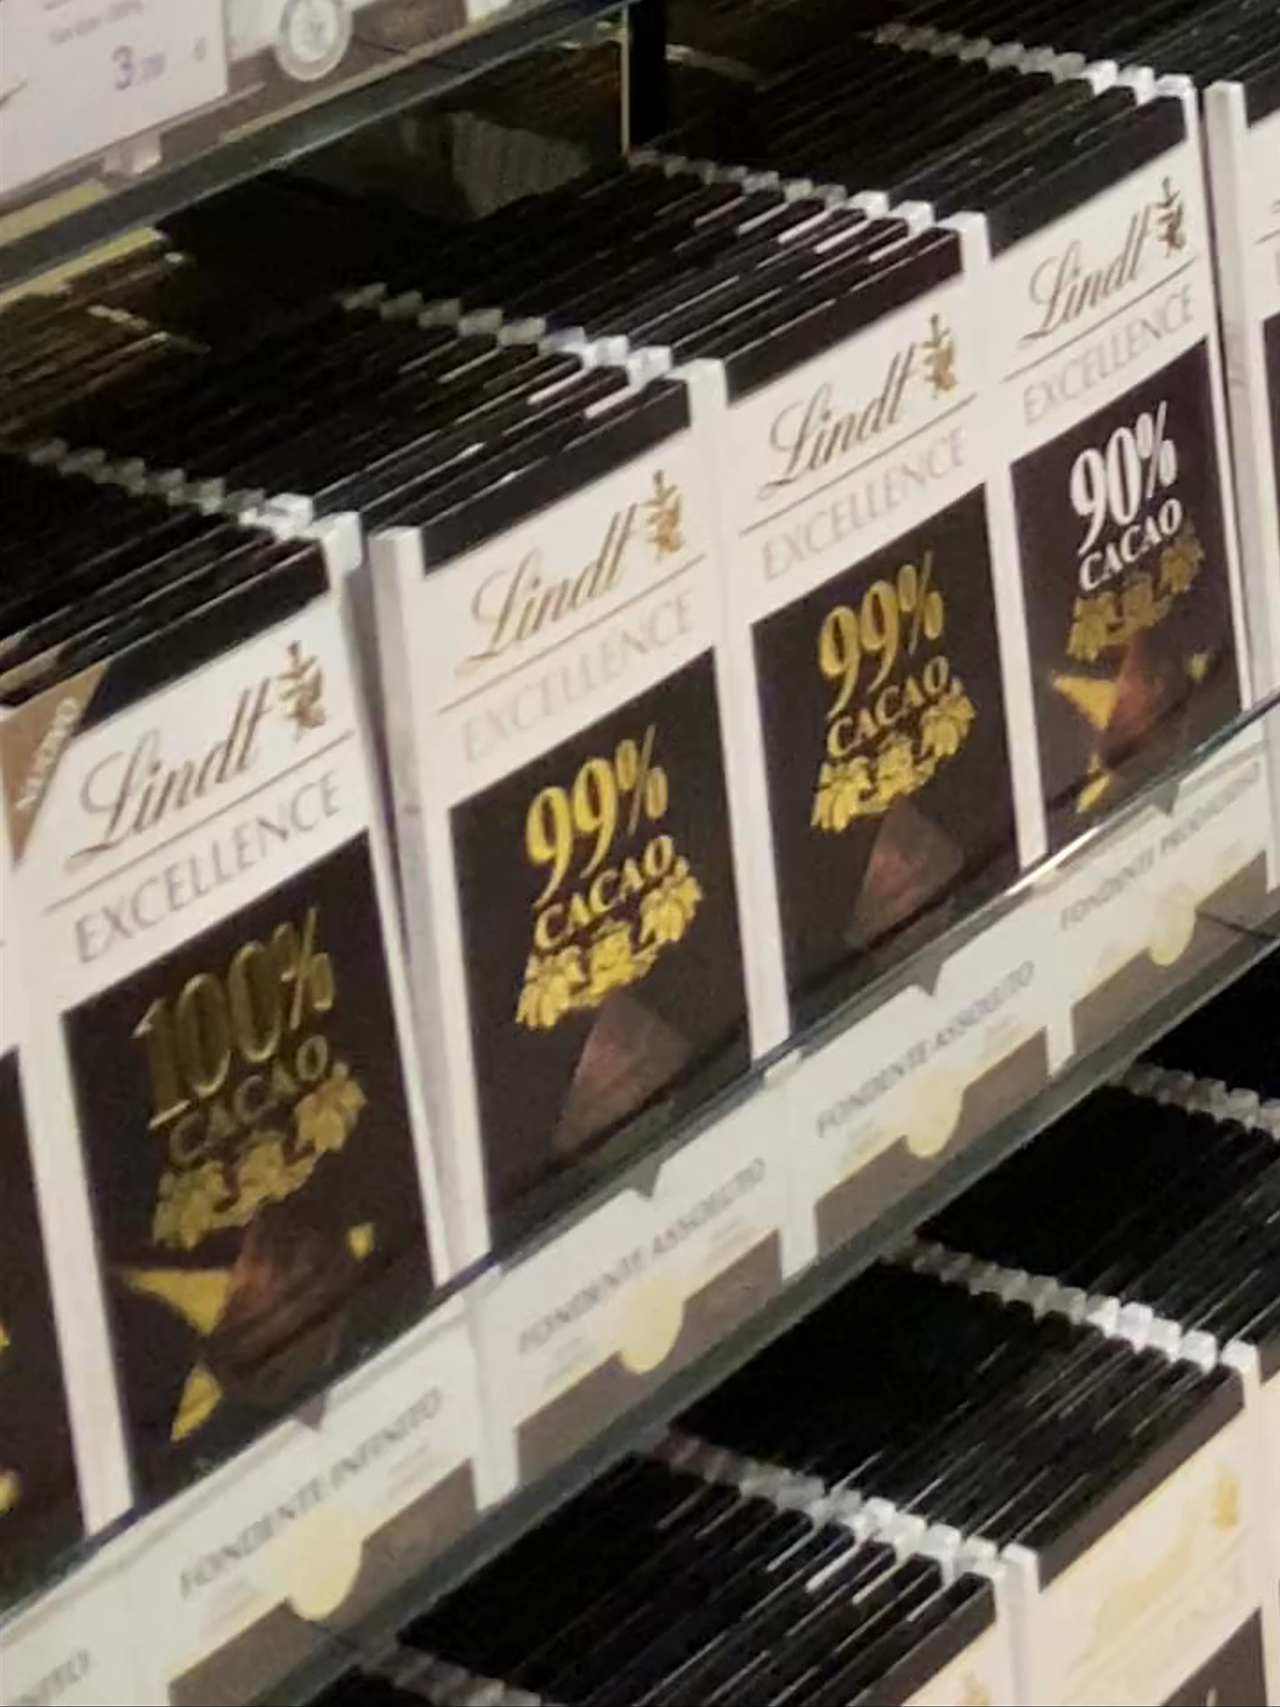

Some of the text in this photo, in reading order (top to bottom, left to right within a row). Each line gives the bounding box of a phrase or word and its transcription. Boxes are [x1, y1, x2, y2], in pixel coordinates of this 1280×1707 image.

[1017, 203, 1146, 346] Lindt
[757, 347, 916, 502] Lindt
[1070, 402, 1179, 557] 90%
[763, 427, 966, 582] EXCELLENCE
[1080, 496, 1184, 593] CACAO
[459, 514, 638, 681] Lindt
[818, 550, 943, 710] 99%
[81, 675, 272, 858] Lindt
[828, 656, 949, 759] CACAO
[74, 773, 344, 961] EXCELLENCE
[525, 723, 668, 902] 99%
[533, 834, 678, 947] CACAO
[134, 908, 332, 1128] 100%
